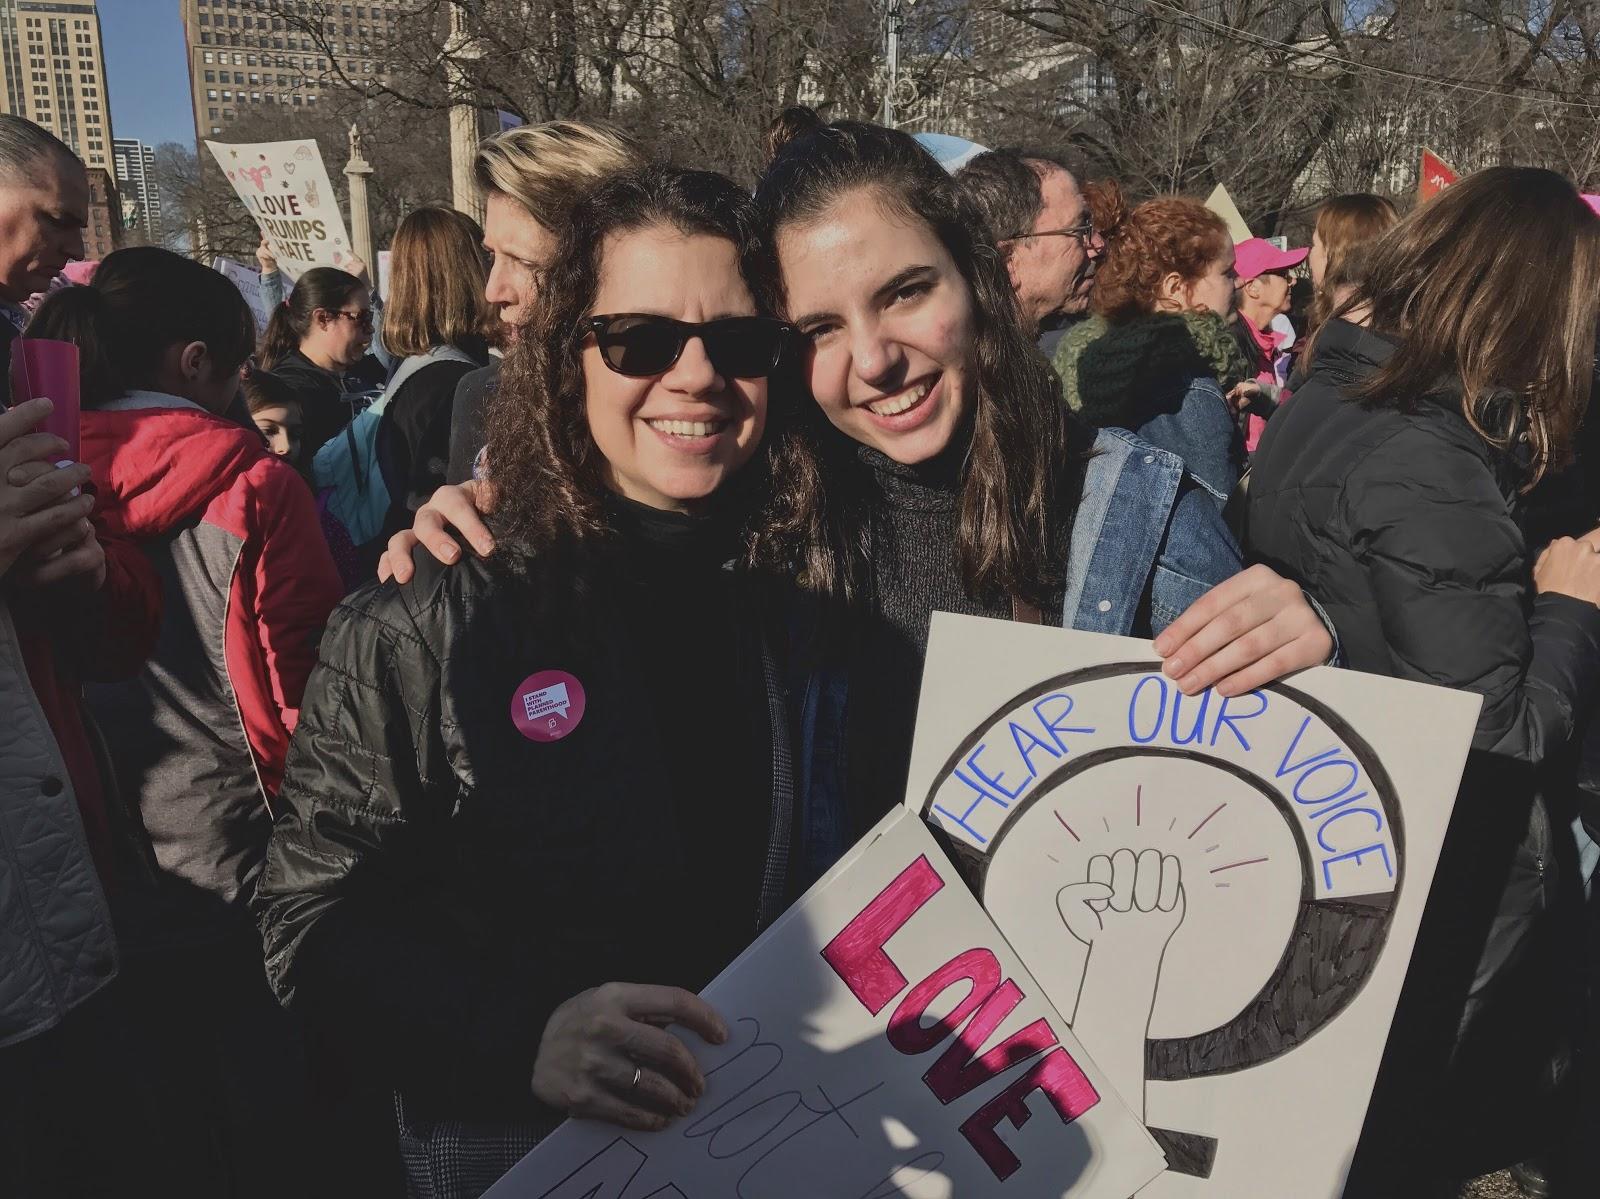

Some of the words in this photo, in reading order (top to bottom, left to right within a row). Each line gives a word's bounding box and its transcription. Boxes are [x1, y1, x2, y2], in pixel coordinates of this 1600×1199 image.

[252, 194, 302, 216] LOVE
[273, 238, 316, 262] HATE
[526, 698, 542, 707] WITH
[528, 691, 547, 700] STAND
[528, 699, 554, 711] PLANNED
[529, 700, 568, 717] PARENTHOOD
[934, 693, 1096, 844] HEAR
[1128, 675, 1269, 752] OUR
[1275, 715, 1394, 891] VOICE
[819, 853, 1102, 1183] LOVE
[683, 1017, 885, 1199] not
